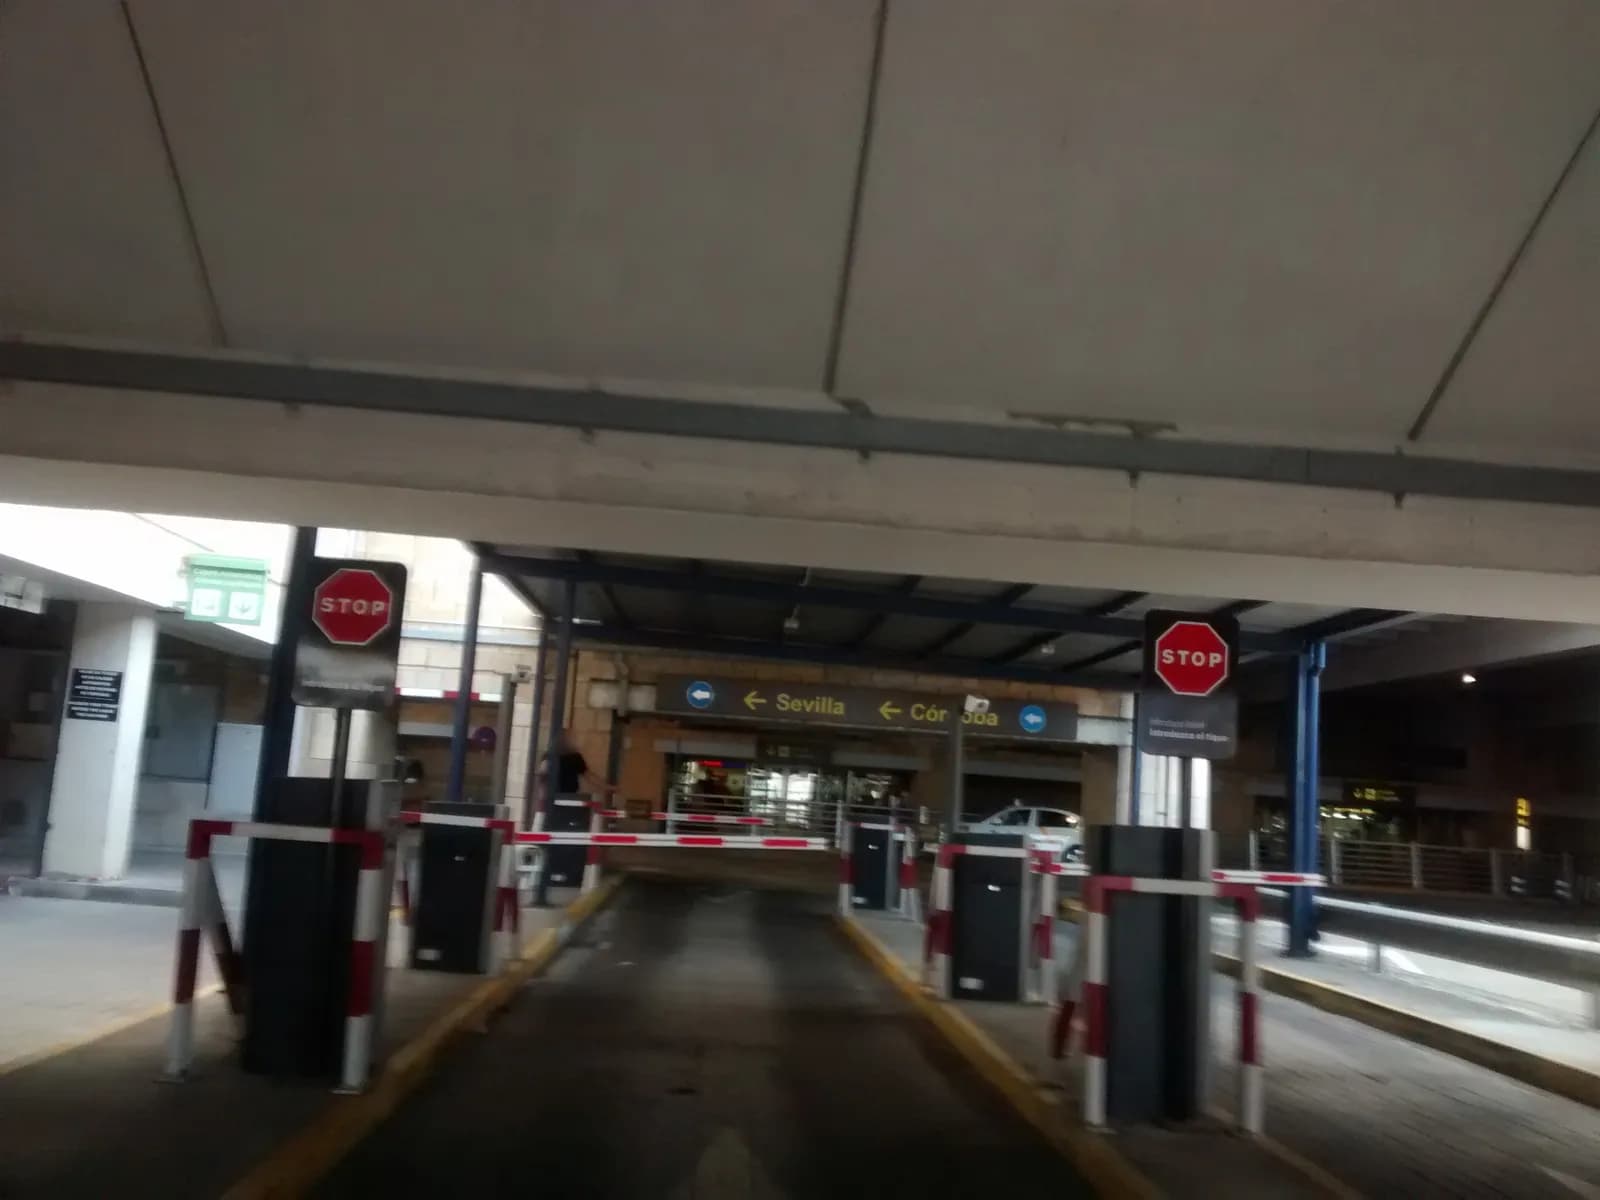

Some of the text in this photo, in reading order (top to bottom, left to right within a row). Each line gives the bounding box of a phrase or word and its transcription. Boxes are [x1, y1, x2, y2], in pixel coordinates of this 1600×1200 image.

[320, 597, 386, 617] STOP
[1161, 648, 1222, 668] STOP
[776, 693, 846, 715] Sevilla
[910, 703, 999, 726] Córoba
